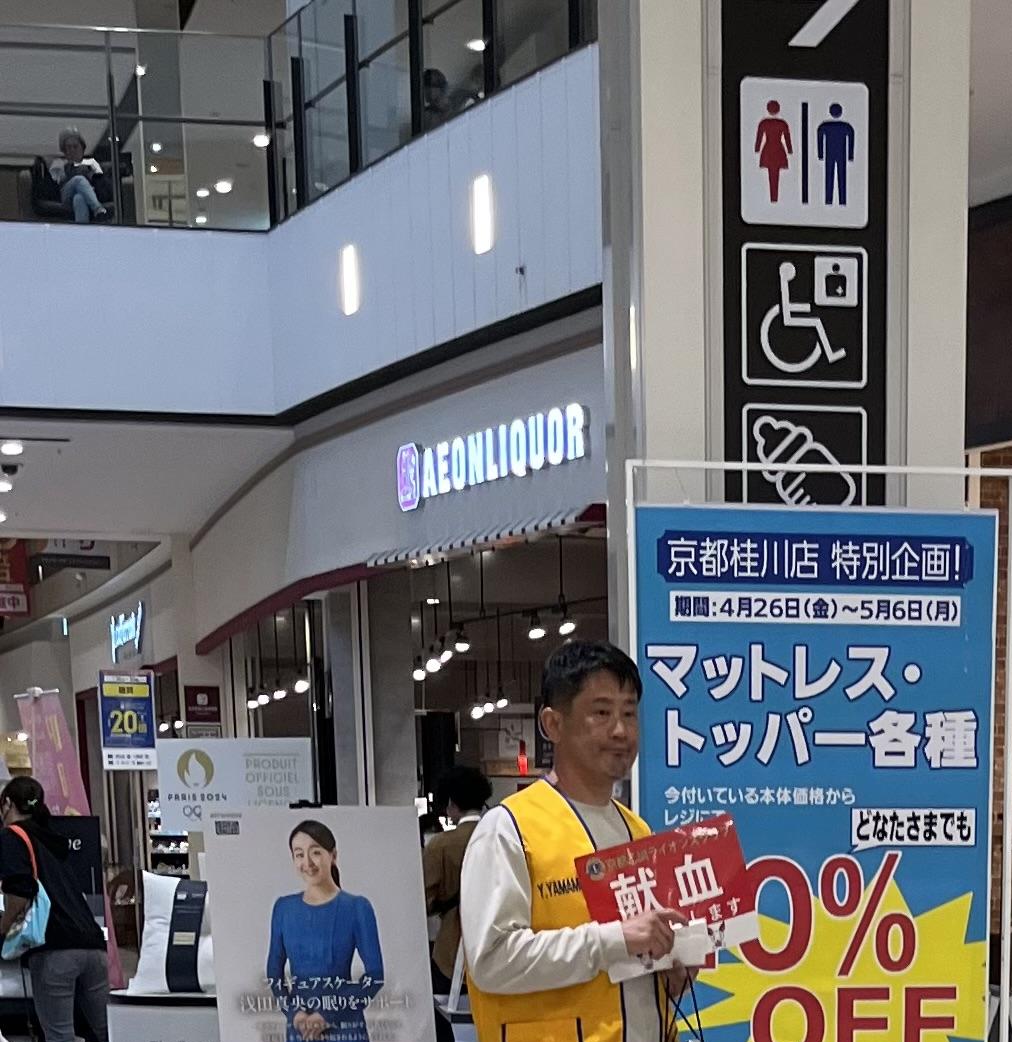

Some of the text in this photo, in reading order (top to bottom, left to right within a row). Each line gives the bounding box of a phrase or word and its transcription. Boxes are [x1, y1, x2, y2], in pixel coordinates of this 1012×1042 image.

[667, 538, 960, 582] 京都桂川店 特別企画!
[646, 643, 923, 702] マットレス・
[665, 706, 979, 768] トッパー各種
[245, 758, 297, 769] PRODUIT
[167, 792, 227, 801] PARIS 2024
[664, 786, 856, 805] 今付いている本体価格から
[856, 811, 971, 842] どなたさまでも
[609, 853, 724, 922] 献血
[701, 851, 917, 977] 0%
[264, 975, 386, 993] フィギュアスケーター
